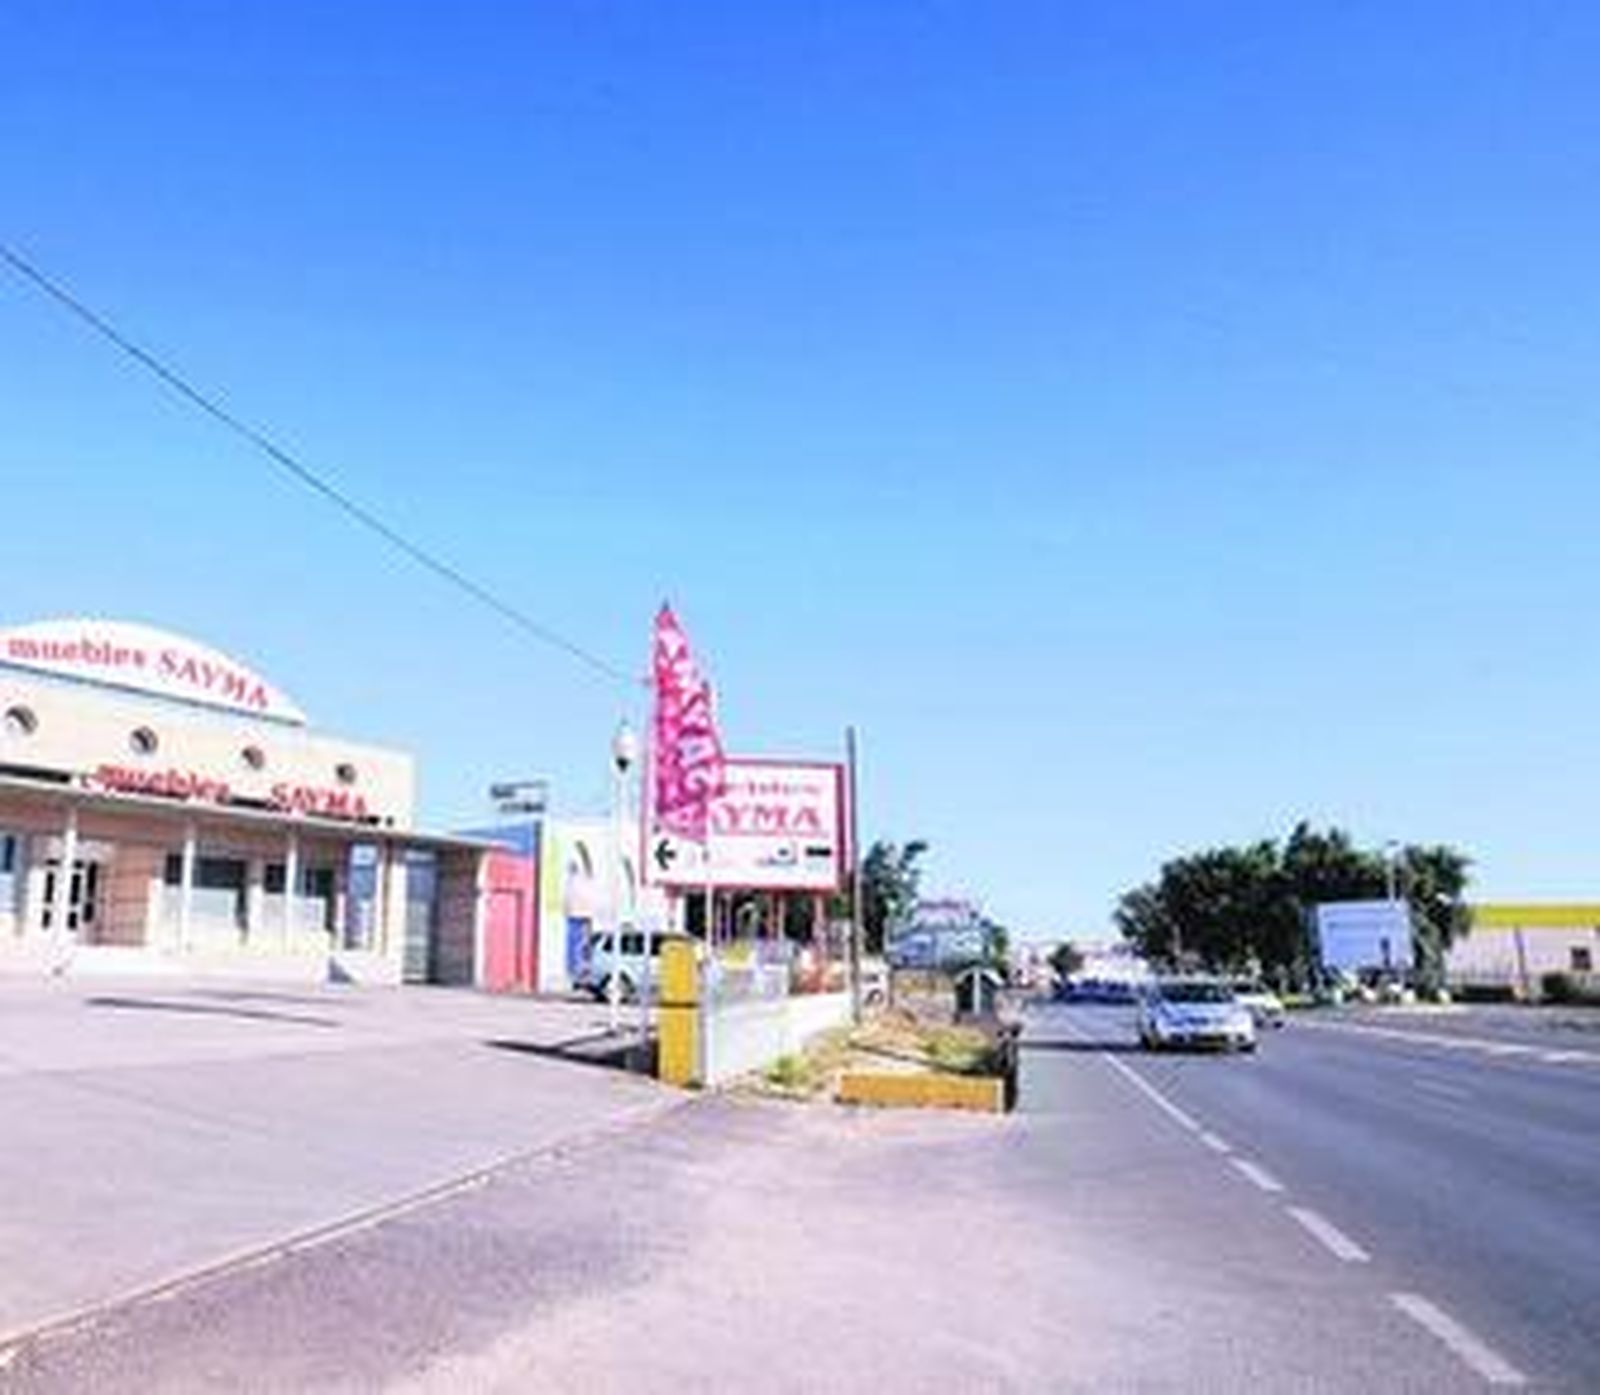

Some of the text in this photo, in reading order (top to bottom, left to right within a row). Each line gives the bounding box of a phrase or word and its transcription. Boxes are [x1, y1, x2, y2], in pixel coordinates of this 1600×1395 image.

[7, 635, 270, 709] muebles SAYMA
[95, 763, 369, 818] muebles SAYMA
